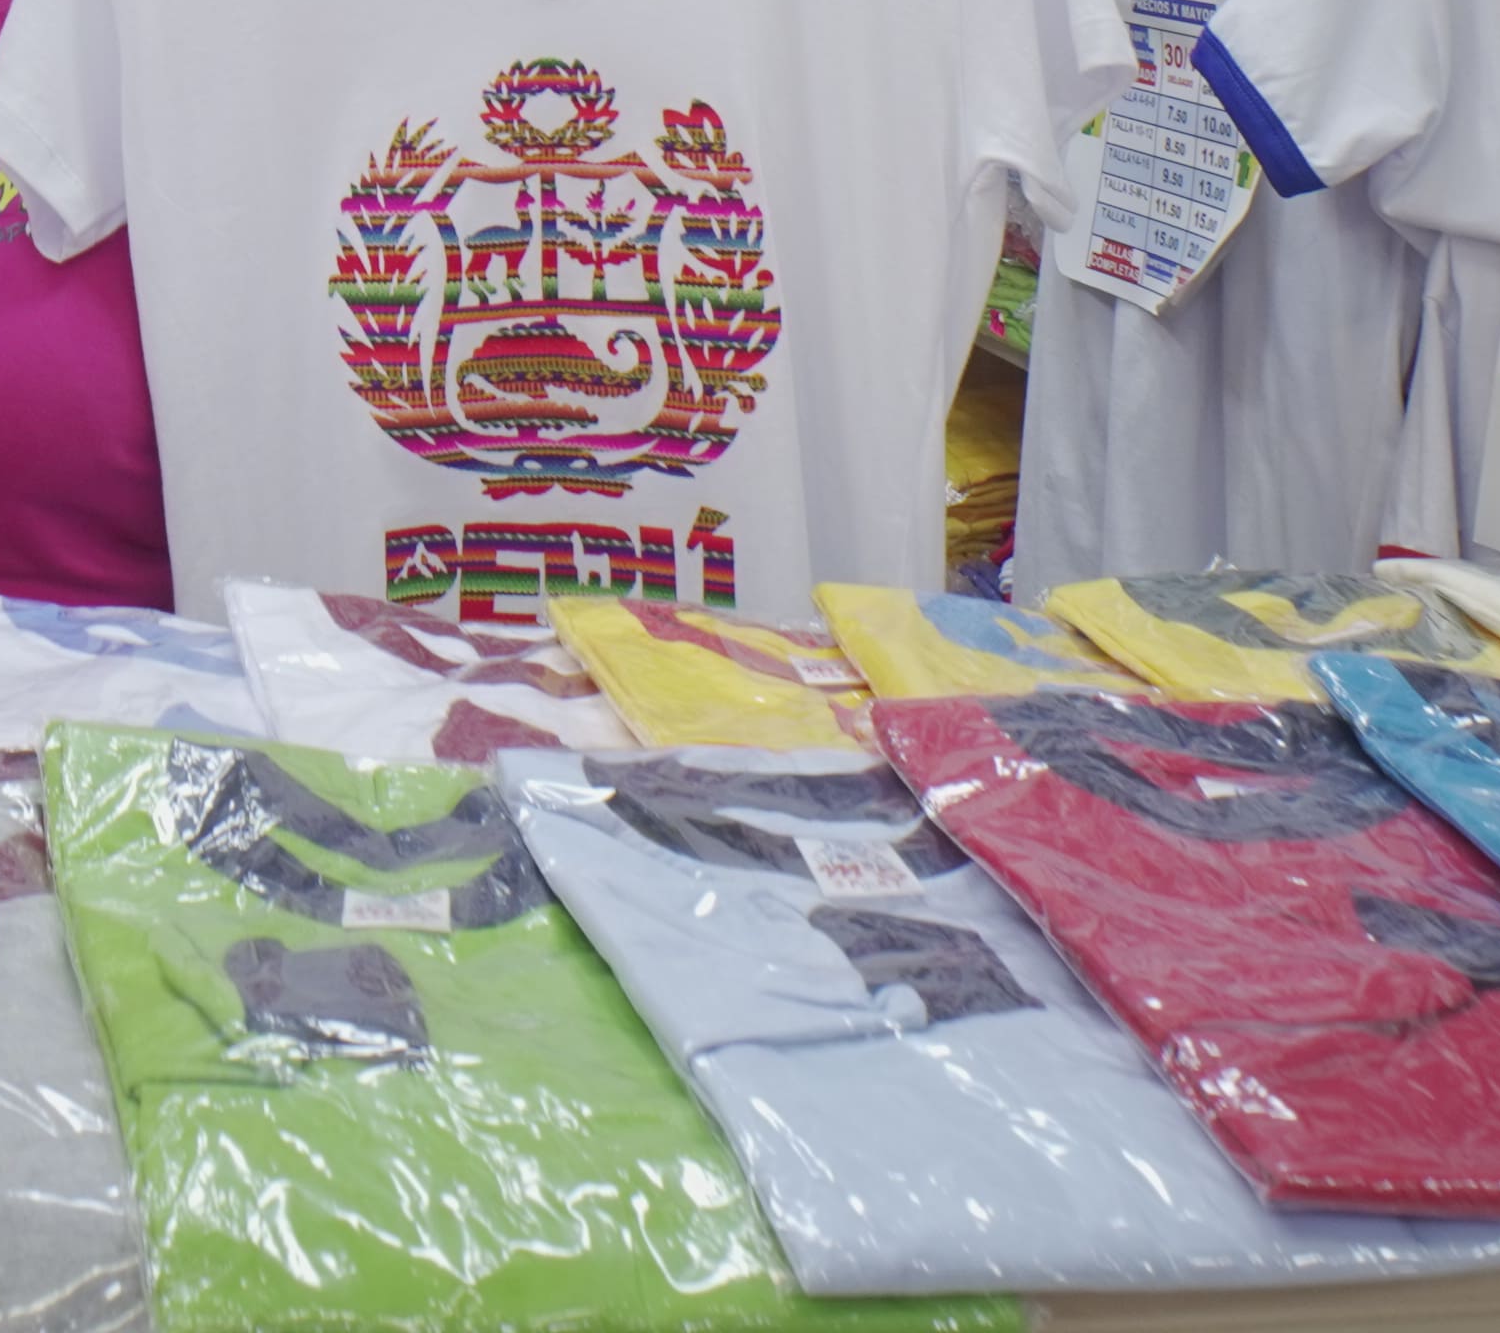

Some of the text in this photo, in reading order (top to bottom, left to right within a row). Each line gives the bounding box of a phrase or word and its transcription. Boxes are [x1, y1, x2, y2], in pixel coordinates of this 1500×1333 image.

[1111, 117, 1134, 134] TALLA
[1164, 137, 1186, 157] 8.50
[1200, 148, 1230, 171] 11.00
[1166, 105, 1188, 125] 7.50
[1201, 114, 1232, 138] 10.00
[1104, 176, 1127, 195] TALLA
[1154, 197, 1182, 221] 11.50
[1193, 210, 1219, 234] 15.00
[1162, 167, 1184, 188] 9.50
[1199, 178, 1226, 203] 13.00
[1101, 206, 1126, 226] TALLA
[1153, 228, 1180, 252] 15.00
[385, 505, 737, 624] PERÚ
